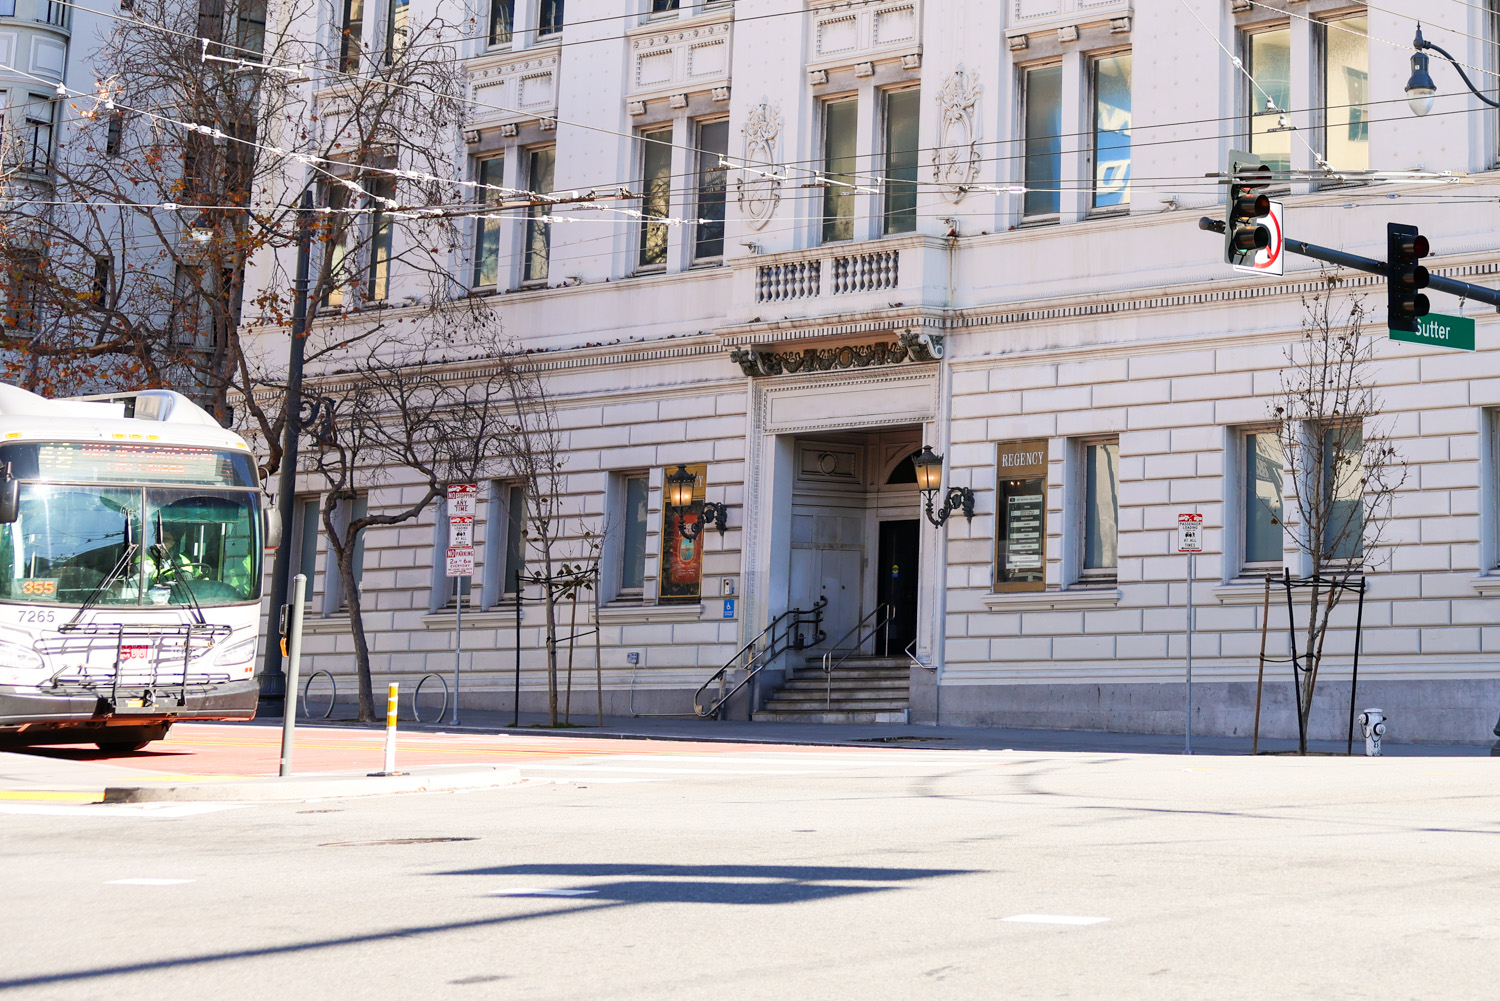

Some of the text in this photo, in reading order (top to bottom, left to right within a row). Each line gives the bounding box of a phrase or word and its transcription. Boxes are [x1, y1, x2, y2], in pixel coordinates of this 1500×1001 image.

[1002, 451, 1044, 467] REGENCY
[22, 580, 56, 595] 355
[18, 610, 55, 623] 7265
